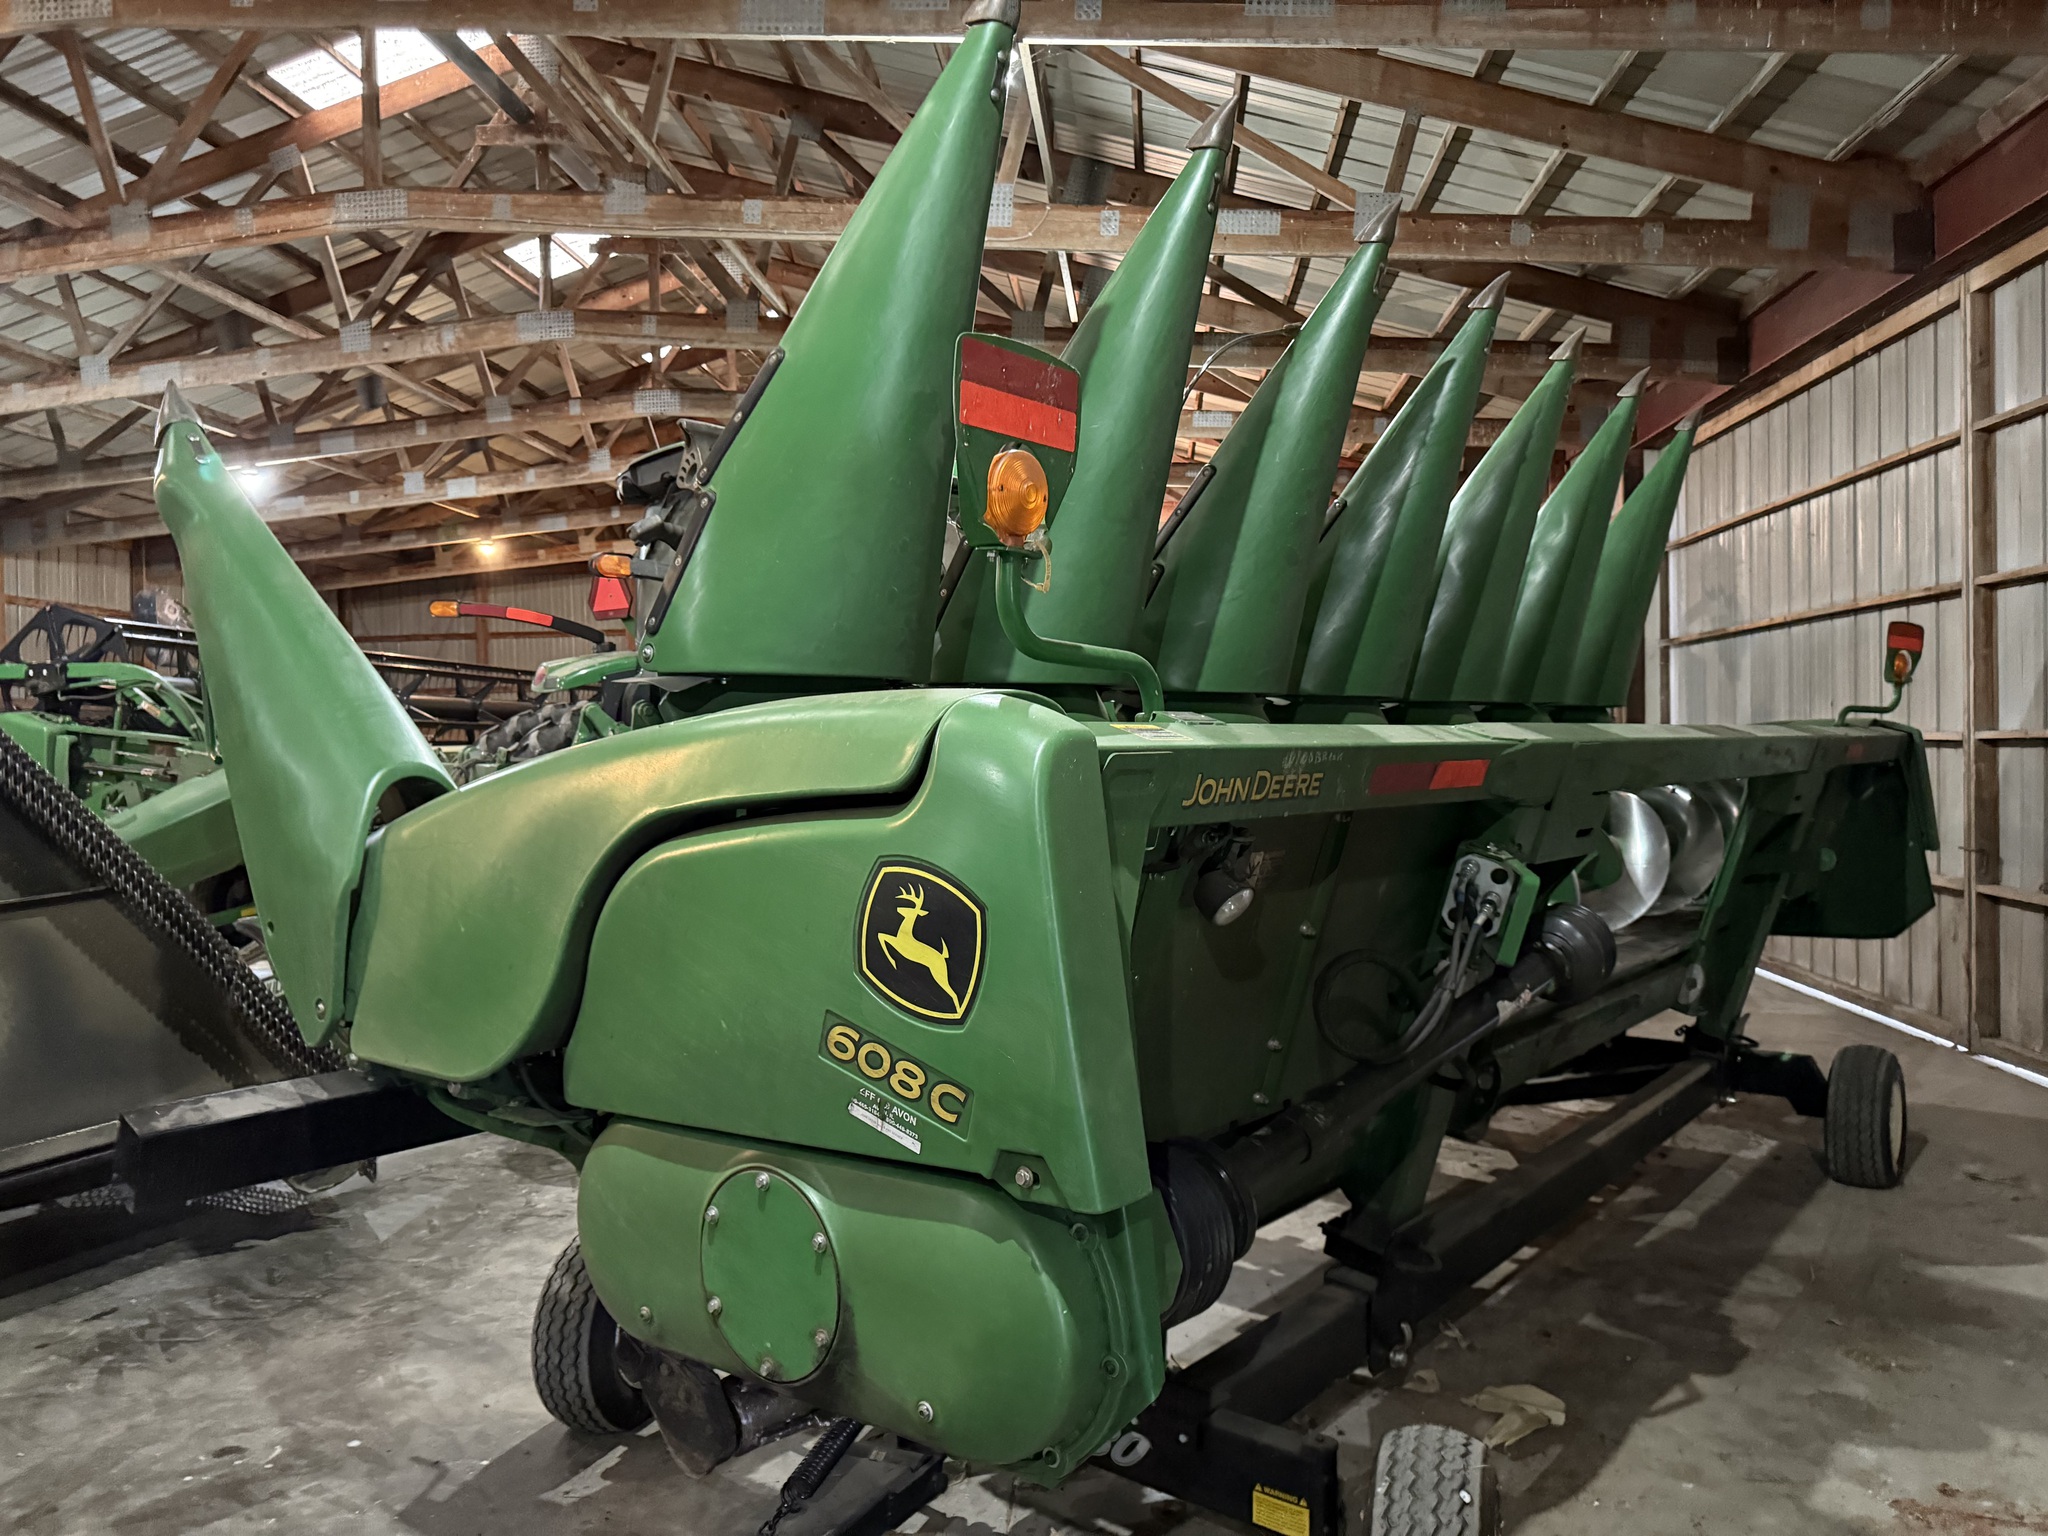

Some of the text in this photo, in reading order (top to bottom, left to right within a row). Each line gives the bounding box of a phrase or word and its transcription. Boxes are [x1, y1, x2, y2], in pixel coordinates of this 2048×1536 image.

[1182, 770, 1324, 807] JOHN DEERE
[826, 1024, 967, 1124] 608C
[891, 1106, 917, 1126] AVON
[1263, 1486, 1299, 1504] WARNING
